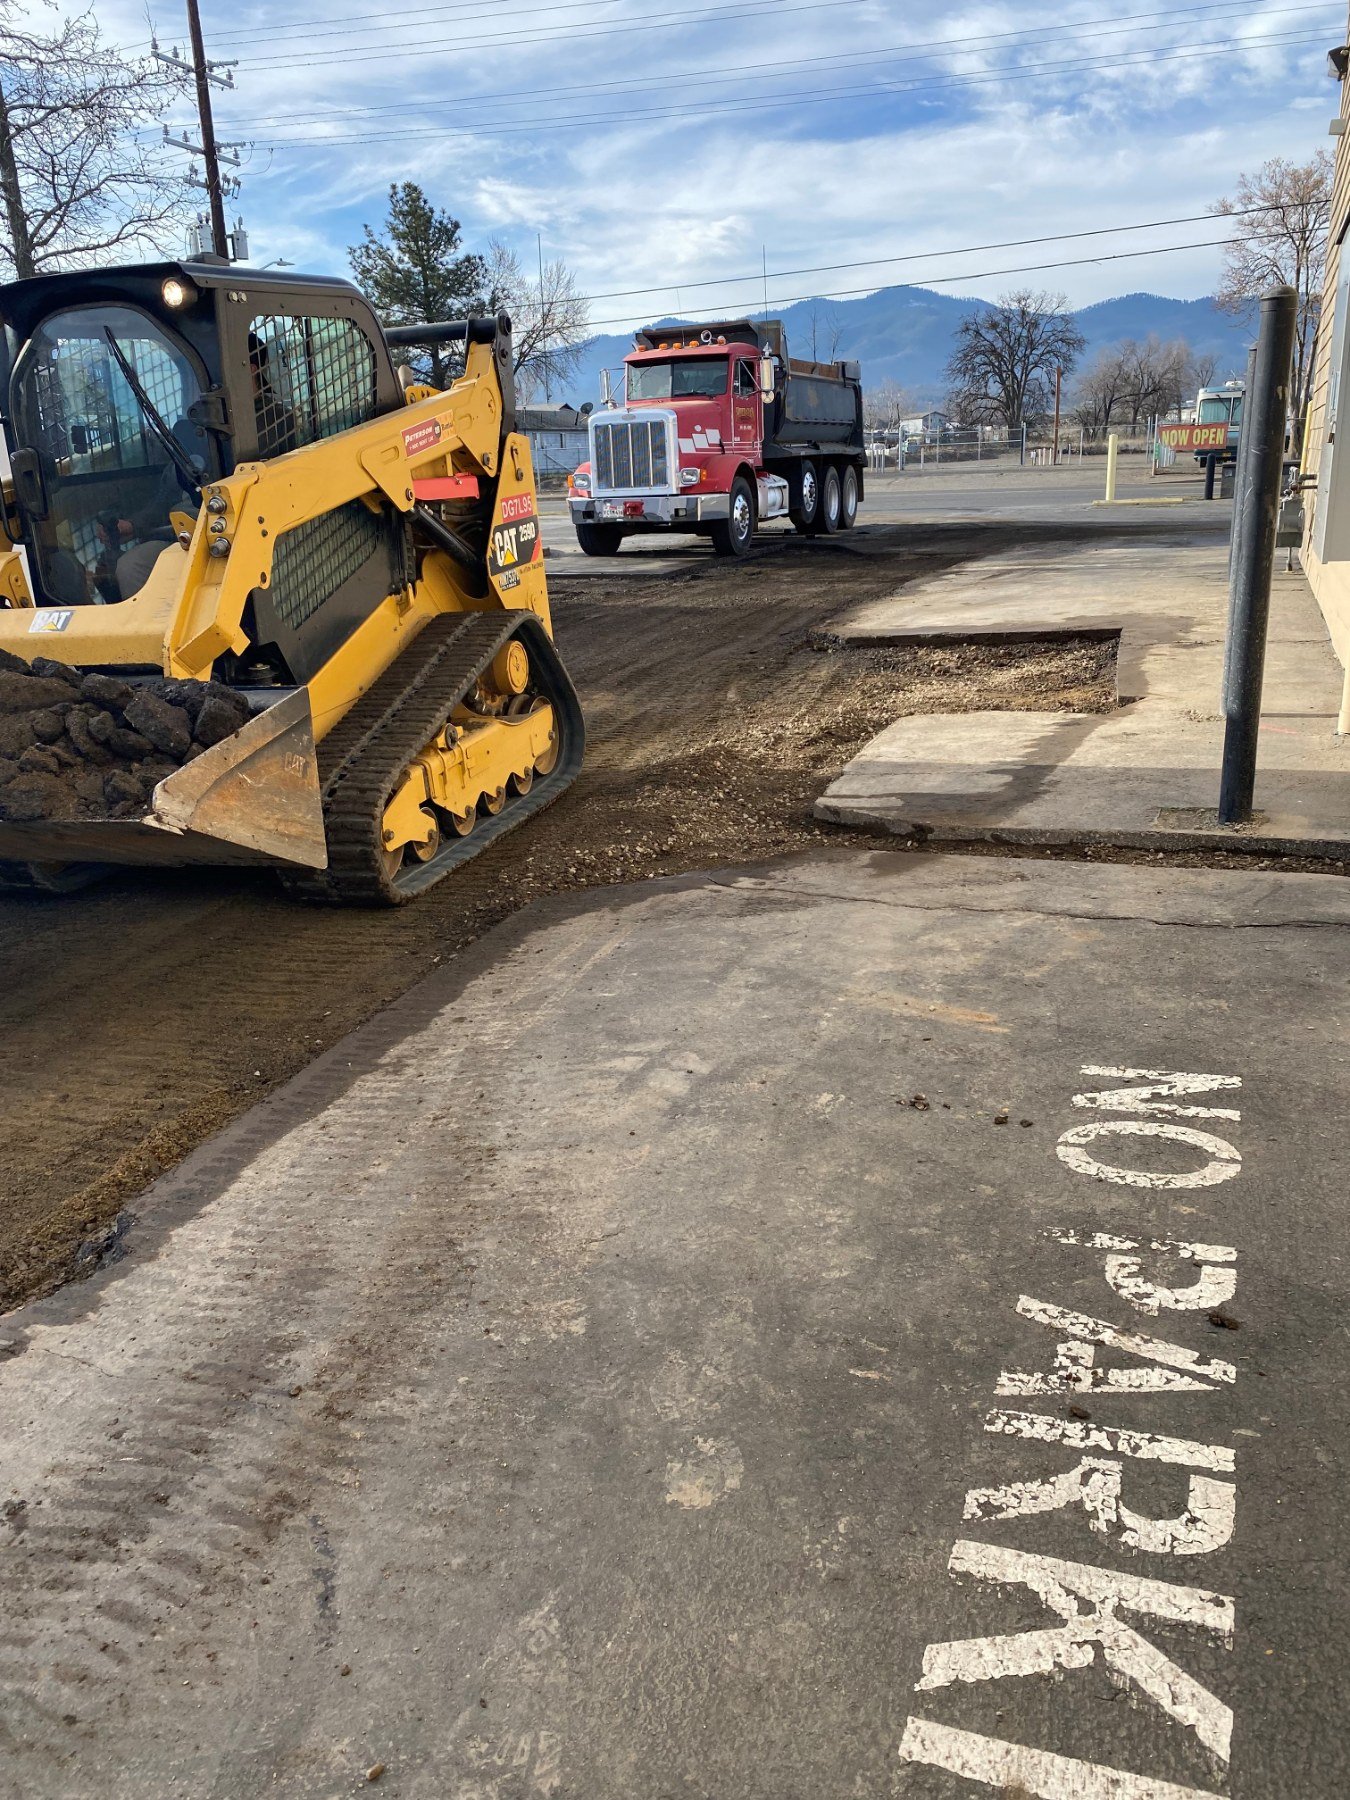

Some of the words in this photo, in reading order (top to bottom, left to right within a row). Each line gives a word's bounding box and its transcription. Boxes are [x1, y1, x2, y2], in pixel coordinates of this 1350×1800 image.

[1162, 430, 1190, 446] NOW
[1192, 428, 1225, 445] OPEN
[494, 527, 518, 567] CAT
[519, 521, 536, 543] 259D
[1056, 1065, 1243, 1189] NO
